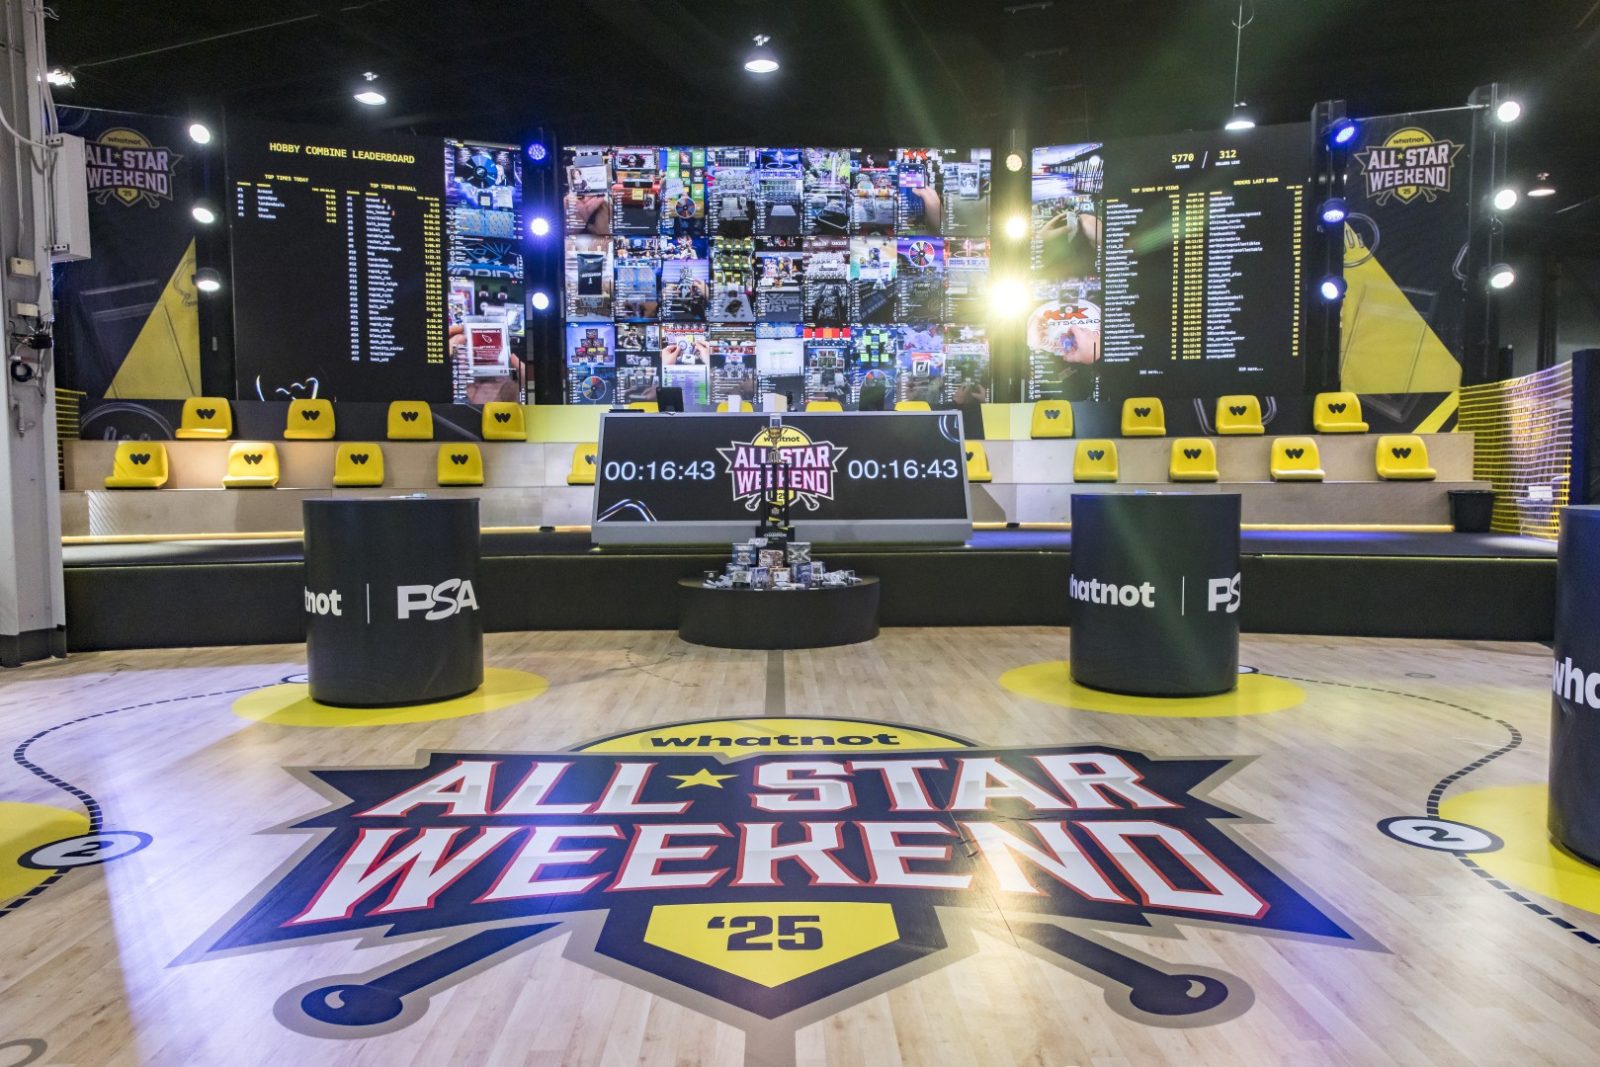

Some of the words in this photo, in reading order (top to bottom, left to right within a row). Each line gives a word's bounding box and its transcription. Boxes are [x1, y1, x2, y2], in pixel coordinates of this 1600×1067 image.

[1393, 136, 1425, 144] whatnot
[86, 145, 117, 166] ALL
[122, 150, 169, 171] STAR
[269, 142, 300, 153] HOBBY
[305, 146, 347, 158] COMBINE
[352, 151, 415, 164] LEADERBOARD
[1171, 153, 1195, 163] 5770
[1219, 149, 1237, 159] 312
[1368, 150, 1401, 170] ALL
[1405, 144, 1449, 167] STAR
[87, 168, 168, 195] WEEKEND
[1369, 166, 1446, 193] WEEKEND
[780, 446, 829, 468] STAR
[848, 459, 958, 479] 00:16:43
[605, 461, 715, 481] 00:16:43
[397, 578, 479, 621] PSA
[650, 732, 899, 747] whatnot
[353, 761, 694, 817] ALL
[752, 753, 1184, 812] STAR
[1412, 826, 1465, 842] 2
[280, 820, 1270, 928] WEEKEND
[707, 914, 823, 951] '25
